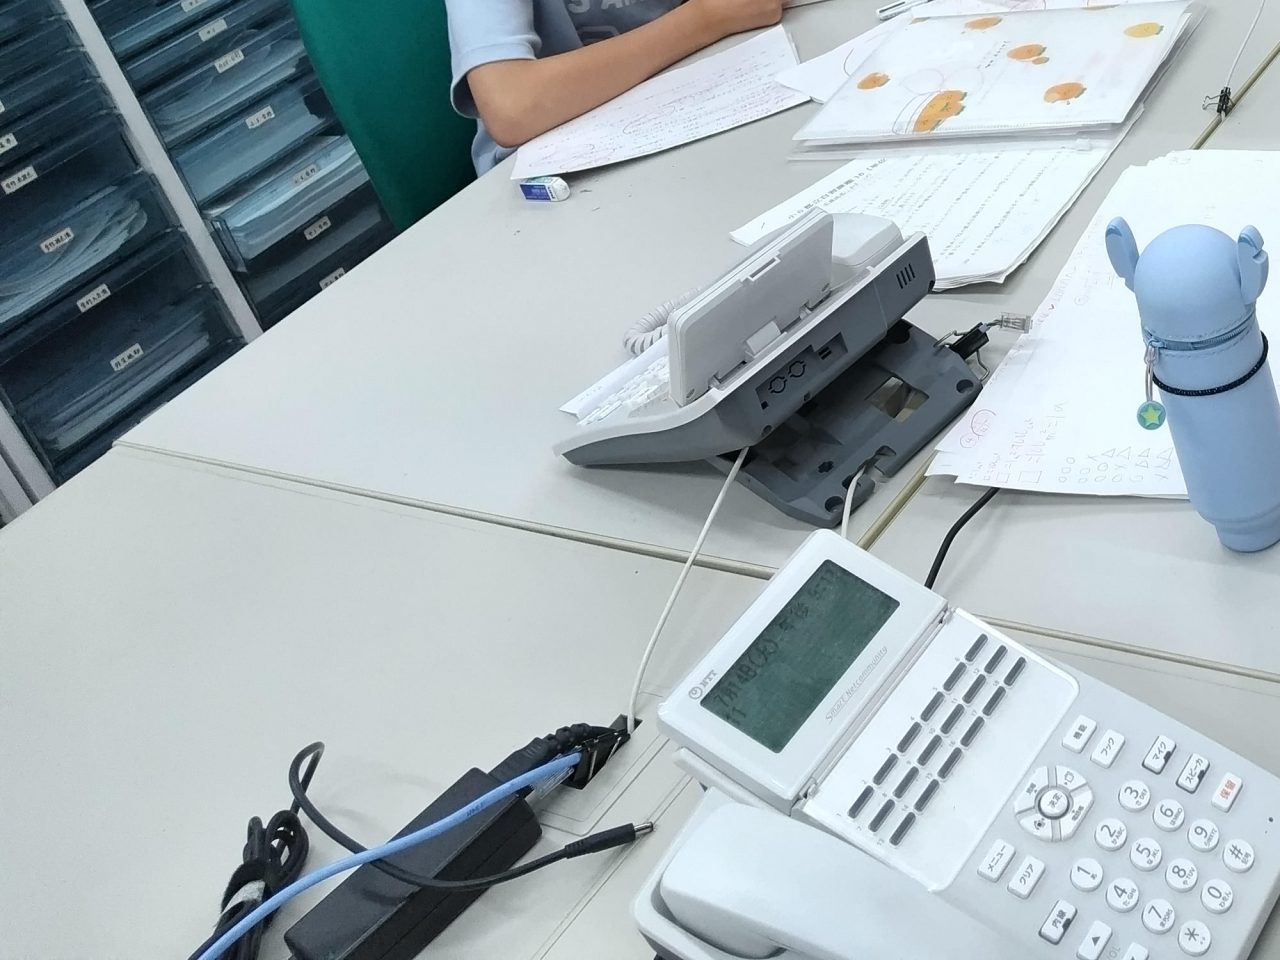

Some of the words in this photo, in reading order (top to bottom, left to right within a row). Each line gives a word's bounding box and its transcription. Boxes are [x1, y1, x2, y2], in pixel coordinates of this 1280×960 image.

[700, 669, 717, 687] NTT
[825, 695, 848, 721] Smart
[846, 648, 887, 694] Netcommunity
[1073, 723, 1086, 739] 機能
[1100, 738, 1115, 755] フック
[1151, 742, 1167, 760] マイク
[1184, 759, 1204, 782] スピーカ
[1124, 785, 1139, 798] 3
[1220, 780, 1235, 798] 保留
[1048, 792, 1062, 807] 決定
[1158, 804, 1173, 818] 6
[1101, 823, 1115, 836] 2
[1193, 825, 1208, 838] 9
[1136, 843, 1151, 857] 5
[1228, 844, 1244, 859] #
[986, 845, 1007, 871] メニュー
[1018, 864, 1035, 883] クリア
[1075, 864, 1089, 877] 1
[1171, 864, 1186, 878] 8
[1111, 883, 1127, 898] 4
[1206, 885, 1222, 899] 0
[1218, 891, 1232, 907] わをん
[1052, 910, 1066, 927] 内線
[1148, 906, 1163, 919] 7
